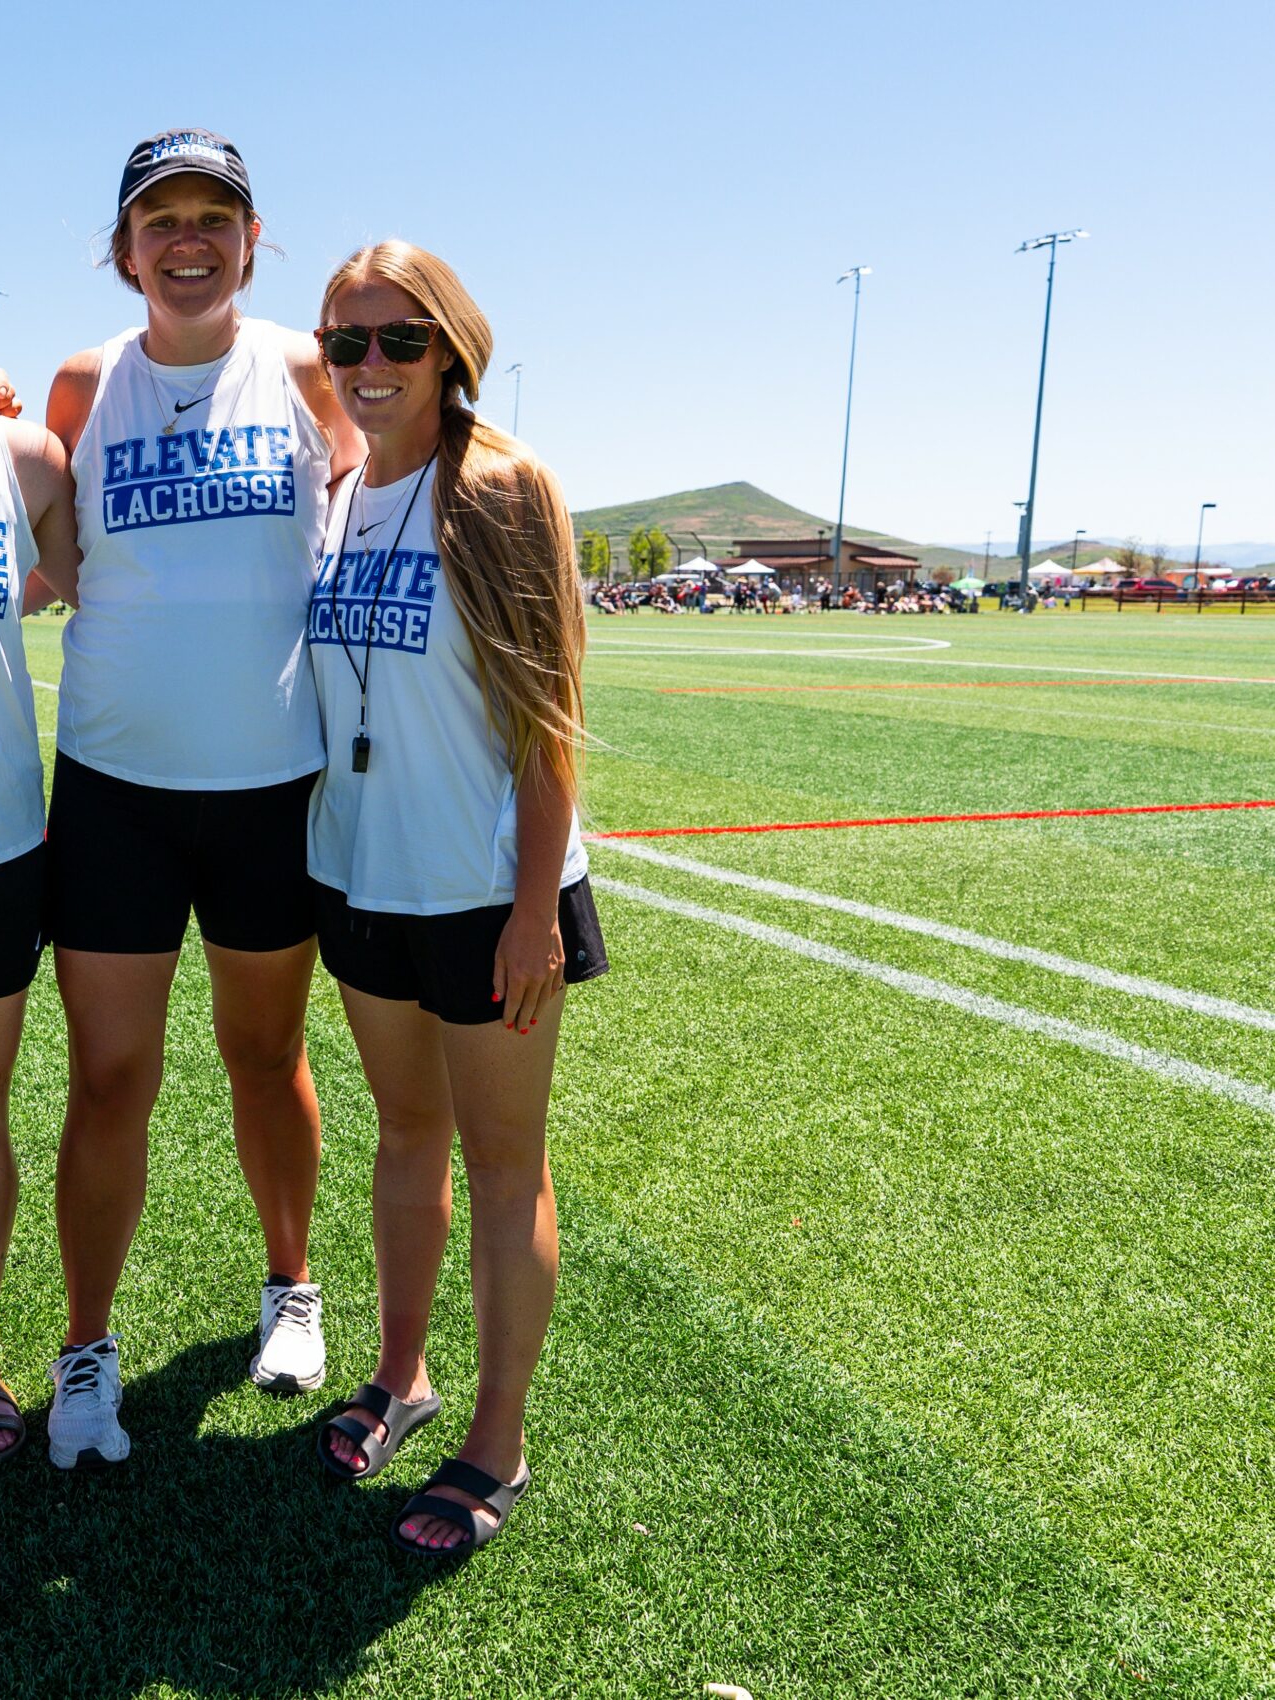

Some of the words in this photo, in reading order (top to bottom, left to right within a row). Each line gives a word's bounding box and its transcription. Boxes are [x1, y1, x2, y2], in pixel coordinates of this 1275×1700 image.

[103, 424, 294, 488] ELEVATE
[105, 475, 294, 529] LACROSSE
[313, 549, 442, 602] LEVATE
[308, 603, 427, 649] CROSSE
